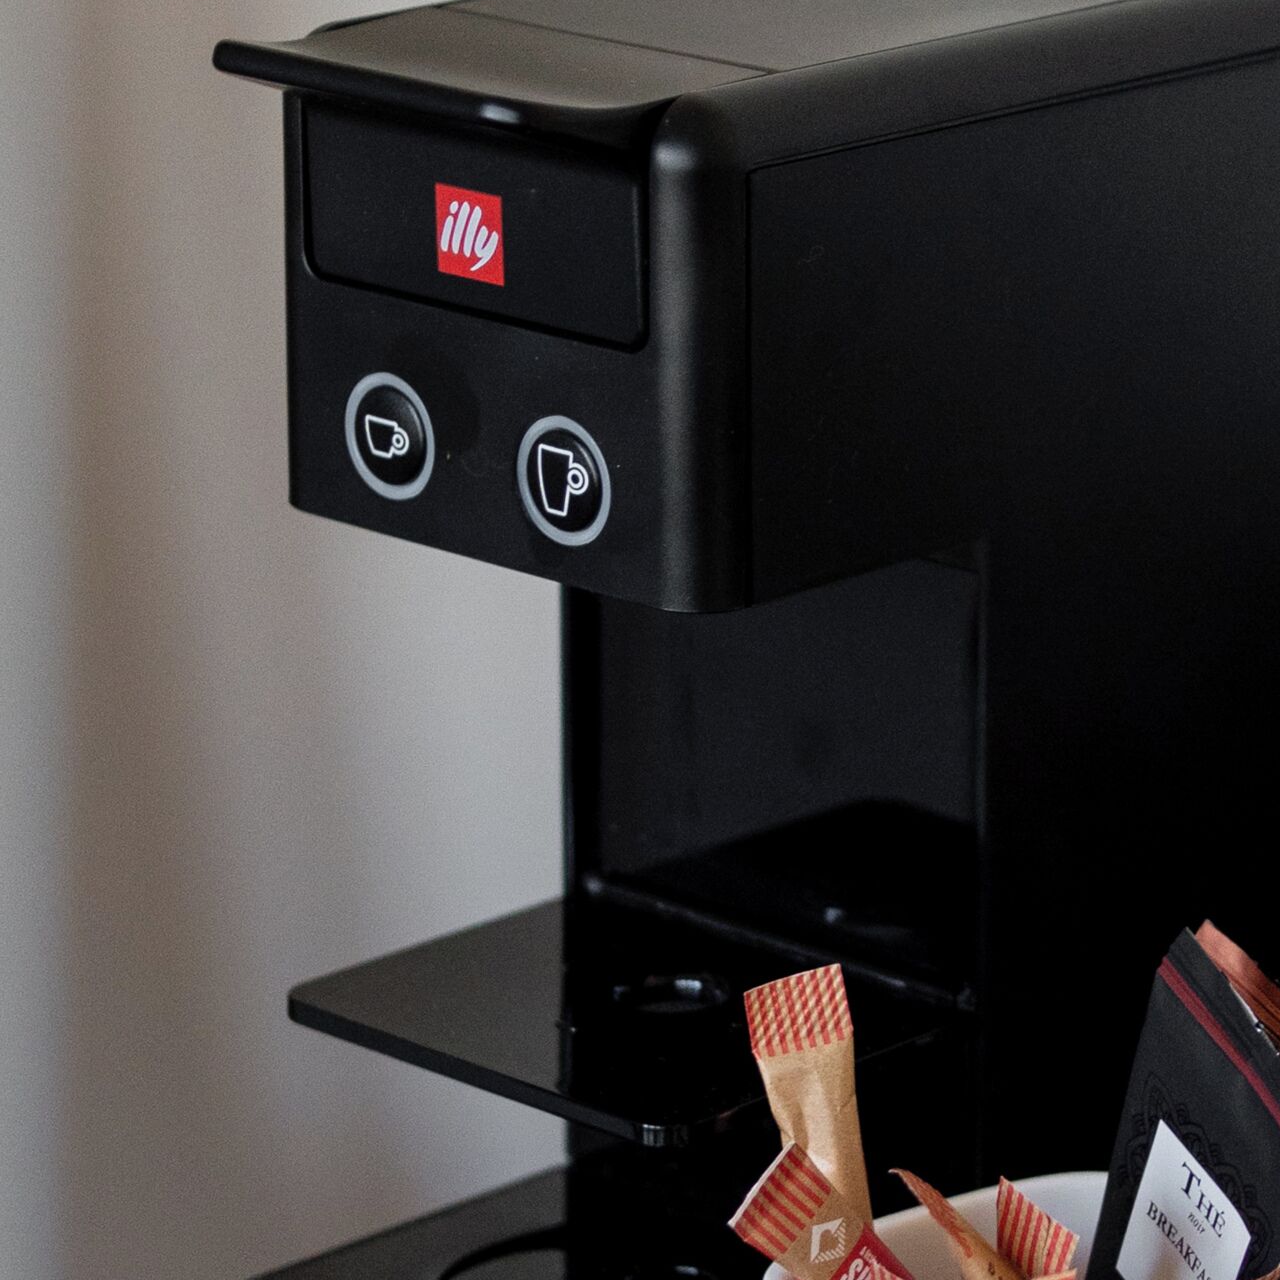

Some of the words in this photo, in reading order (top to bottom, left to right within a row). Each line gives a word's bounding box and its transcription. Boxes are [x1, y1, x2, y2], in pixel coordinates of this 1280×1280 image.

[441, 200, 499, 272] illy
[1181, 1161, 1227, 1238] THÉ
[1187, 1213, 1206, 1235] noir
